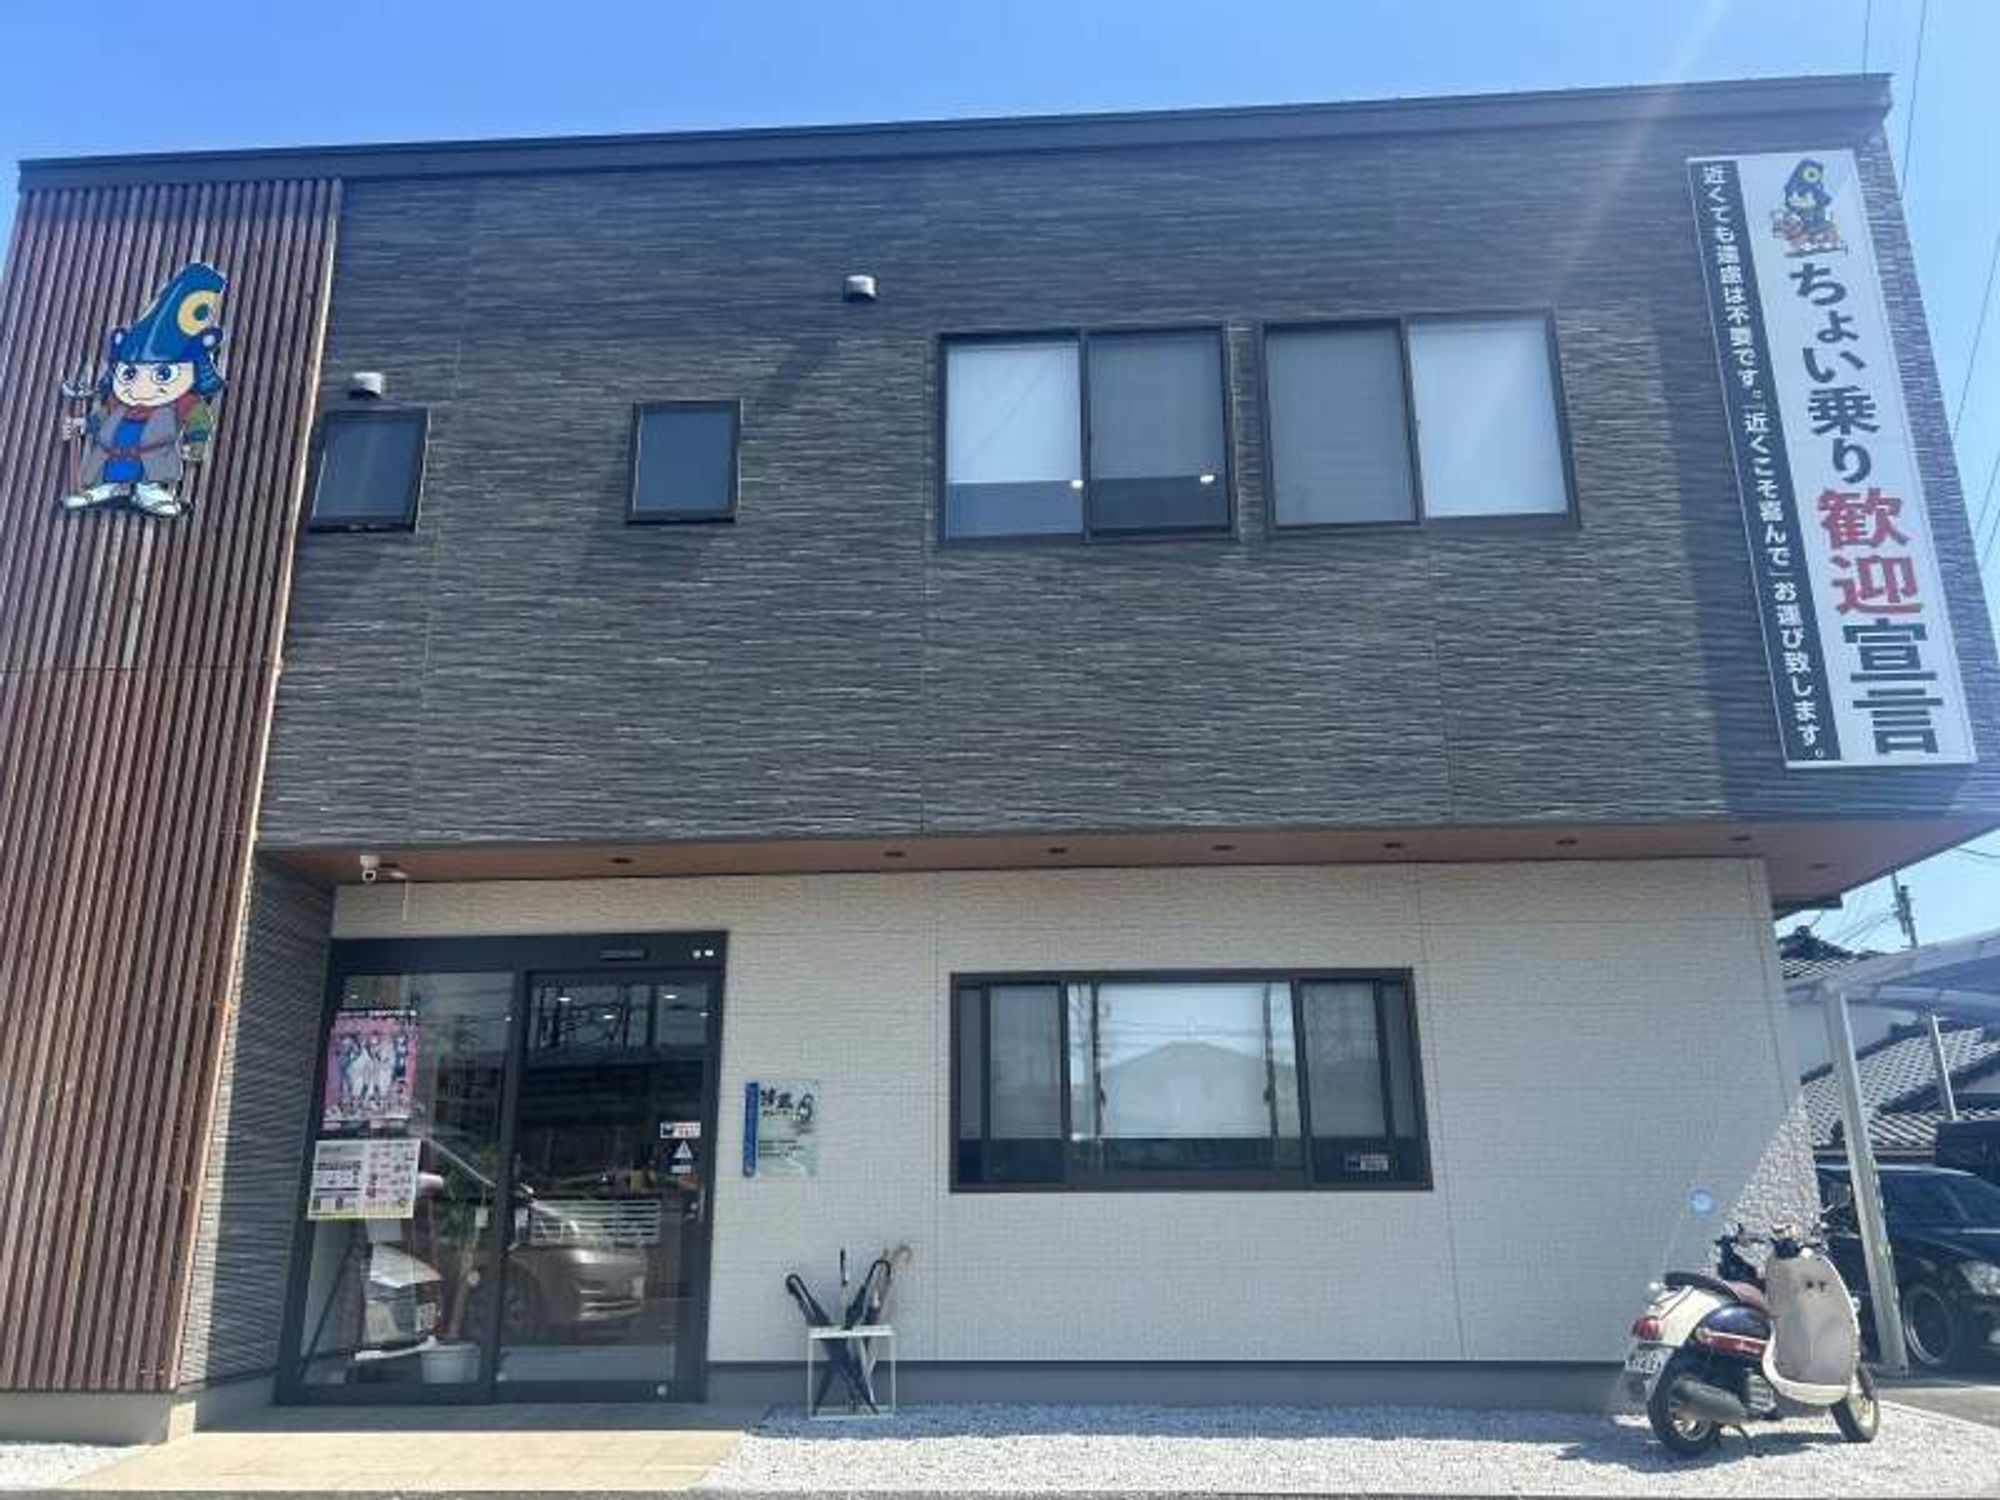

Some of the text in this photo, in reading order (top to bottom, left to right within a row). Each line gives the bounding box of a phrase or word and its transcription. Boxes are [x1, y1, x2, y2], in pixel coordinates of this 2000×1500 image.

[1789, 262, 1944, 754] ちょい乗り歓迎宣言
